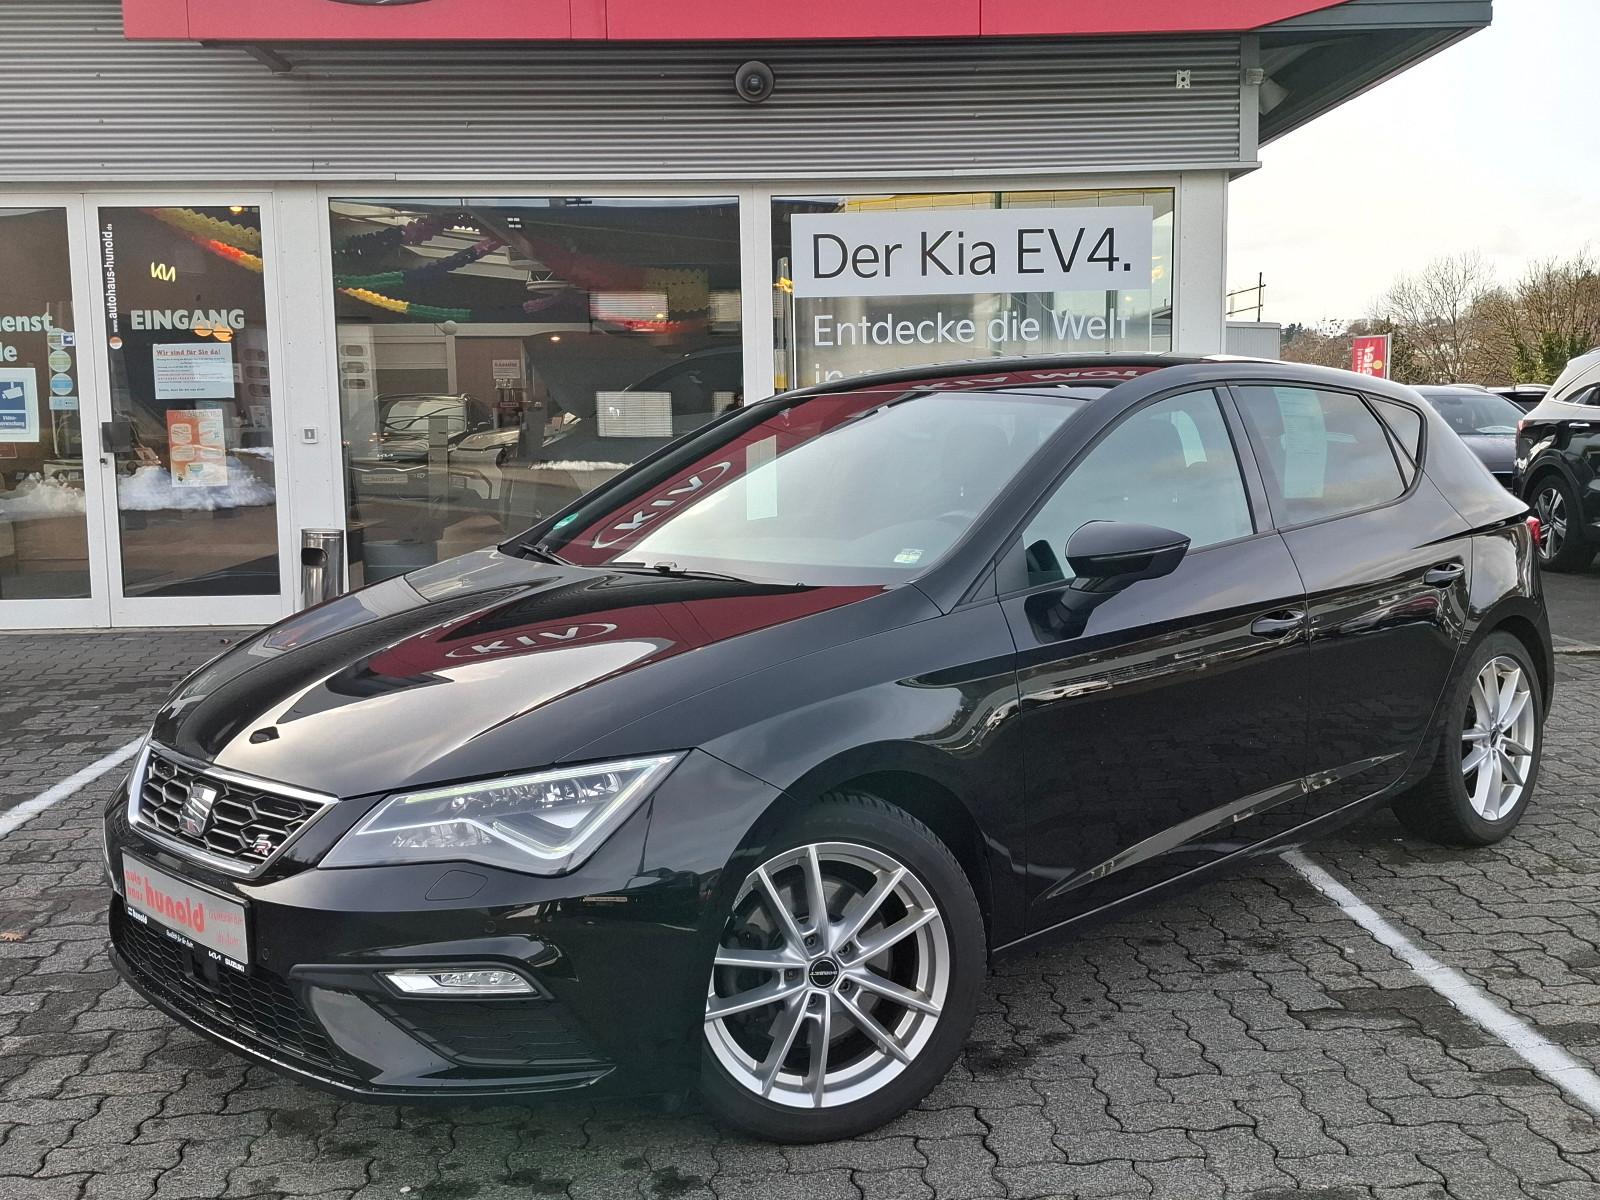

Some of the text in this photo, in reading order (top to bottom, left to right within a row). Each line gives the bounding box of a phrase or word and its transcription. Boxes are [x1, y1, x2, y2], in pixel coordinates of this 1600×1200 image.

[812, 227, 1132, 279] Der Kia EV4.
[130, 309, 245, 331] EINGANG
[814, 308, 1130, 347] Entdecke die Welt
[144, 876, 205, 933] hunold
[225, 957, 245, 973] SUZUKI
